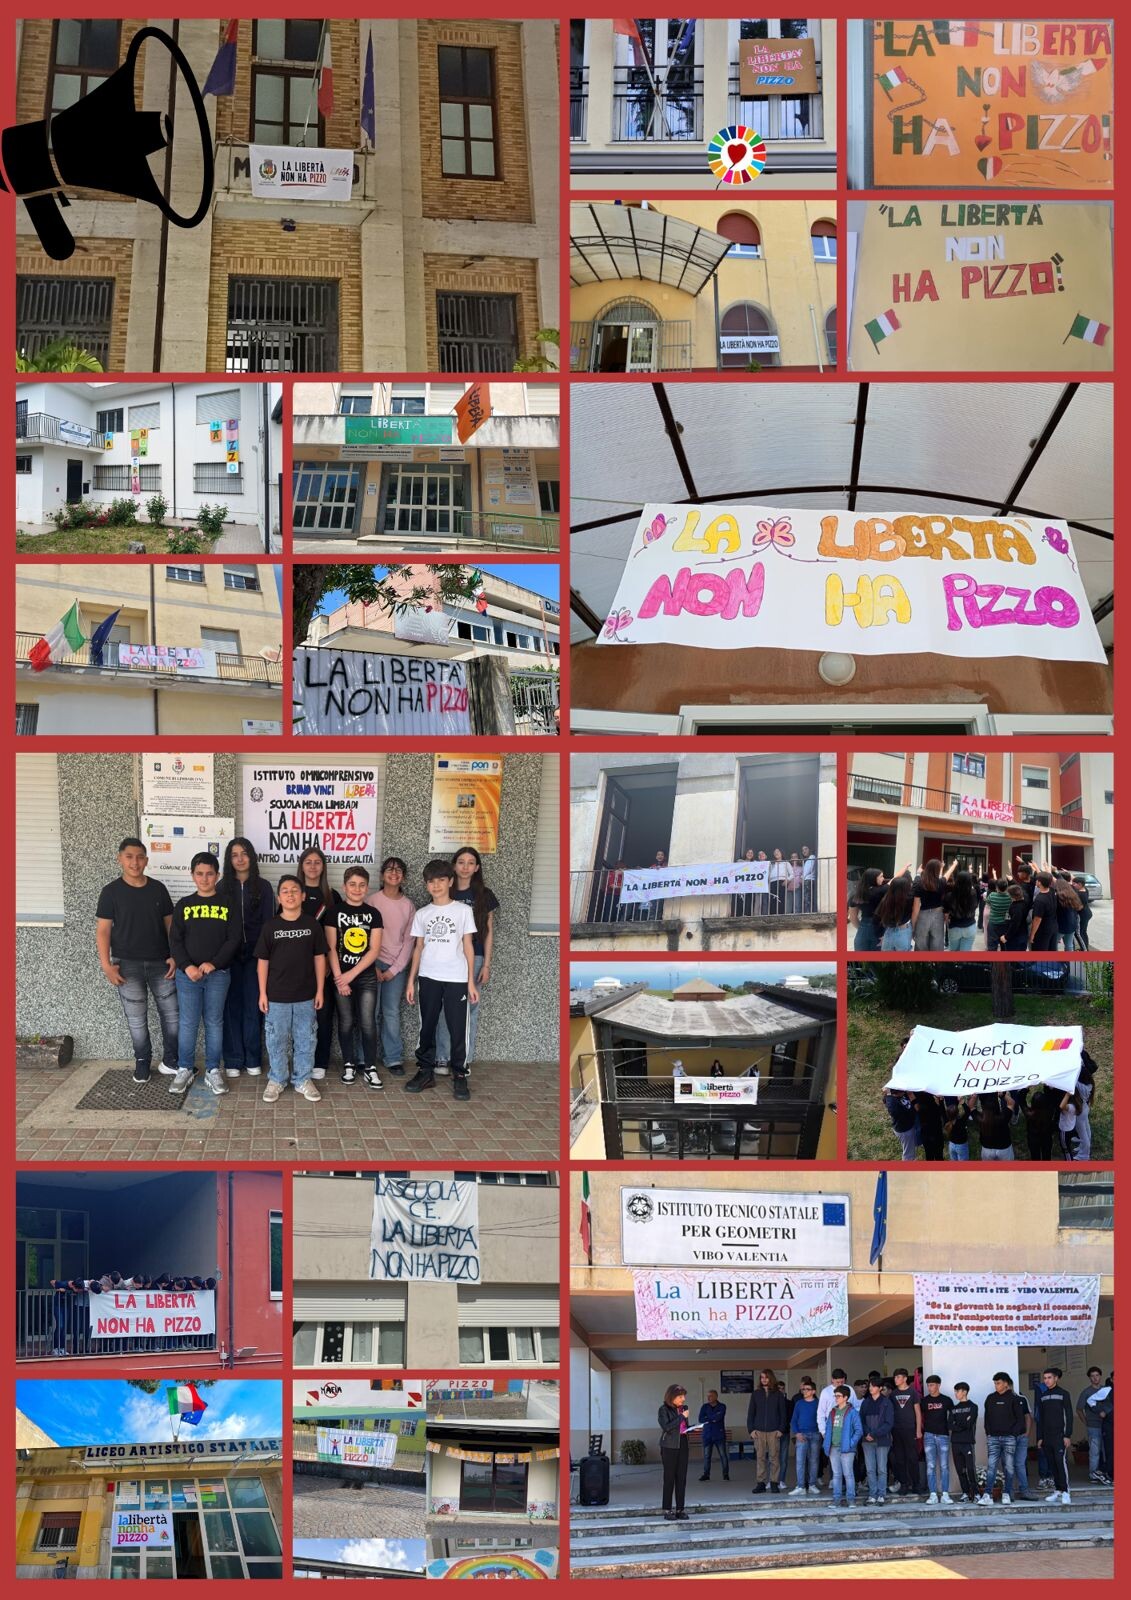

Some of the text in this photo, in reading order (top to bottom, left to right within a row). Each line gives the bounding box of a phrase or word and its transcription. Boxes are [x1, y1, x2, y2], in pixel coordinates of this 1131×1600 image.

[754, 45, 769, 54] LA
[752, 61, 803, 73] NON HA
[756, 76, 794, 85] PIZZO
[957, 65, 1026, 97] NON
[893, 112, 1112, 160] HA PIZZO!
[282, 161, 324, 172] LA LIBERTÀ
[280, 172, 327, 183] NON HA PIZZO
[945, 235, 1005, 262] NON
[893, 270, 940, 303] HA
[720, 340, 726, 349] LA
[765, 340, 779, 348] PIZZO
[348, 429, 378, 438] NON
[228, 419, 237, 472] PIZZO
[672, 511, 741, 553] LA
[638, 562, 1081, 631] NON HA PIZZO
[129, 644, 145, 655] LA
[123, 656, 148, 666] NON
[150, 658, 165, 666] HA
[305, 657, 348, 688] LA
[325, 683, 469, 717] NON HA PIZZO
[253, 770, 295, 781] ISTITUTO
[286, 785, 335, 795] BRUNO VINCI
[270, 800, 358, 809] SCUOLA MEDIA LIMBADI
[962, 795, 977, 808] LA
[292, 808, 355, 830] LIBERTÀ
[963, 807, 981, 818] NON
[984, 811, 994, 820] HA
[269, 832, 320, 851] NON HA
[284, 854, 295, 863] LA
[342, 854, 374, 863] LEGALITÀ
[183, 905, 229, 921] PYREX
[274, 928, 311, 939] Kappa
[927, 1040, 1027, 1056] La libertà
[964, 1058, 1012, 1072] NON
[953, 1073, 1040, 1090] ha pizzo
[720, 1091, 741, 1099] pizzo
[375, 1177, 460, 1201] LA SCUOLA
[657, 1202, 819, 1220] ISTITUTO TECNICO STATALE
[382, 1219, 406, 1242] LA
[682, 1225, 797, 1240] PER GEOMETRI
[693, 1251, 788, 1262] VIBO VALENTIA
[371, 1249, 480, 1280] NON HA PIZZO
[655, 1278, 795, 1299] La LIBERTÀ
[801, 1280, 839, 1289] ITG ITI ITE
[115, 1294, 136, 1308] LA
[954, 1302, 994, 1311] gioventù
[1006, 1303, 1042, 1312] negherà
[670, 1305, 793, 1321] non ha PIZZO
[924, 1312, 951, 1320] anche
[1022, 1313, 1068, 1321] misteriosa
[1070, 1313, 1091, 1321] mafia
[97, 1316, 201, 1334] NON HA PIZZO
[449, 1380, 488, 1388] PIZZO
[344, 1436, 353, 1445] LA
[87, 1439, 279, 1458] LICEO ARTISTICO STATALE
[364, 1446, 375, 1454] HA
[344, 1453, 368, 1462] PIZZO
[117, 1532, 148, 1544] pizzo
